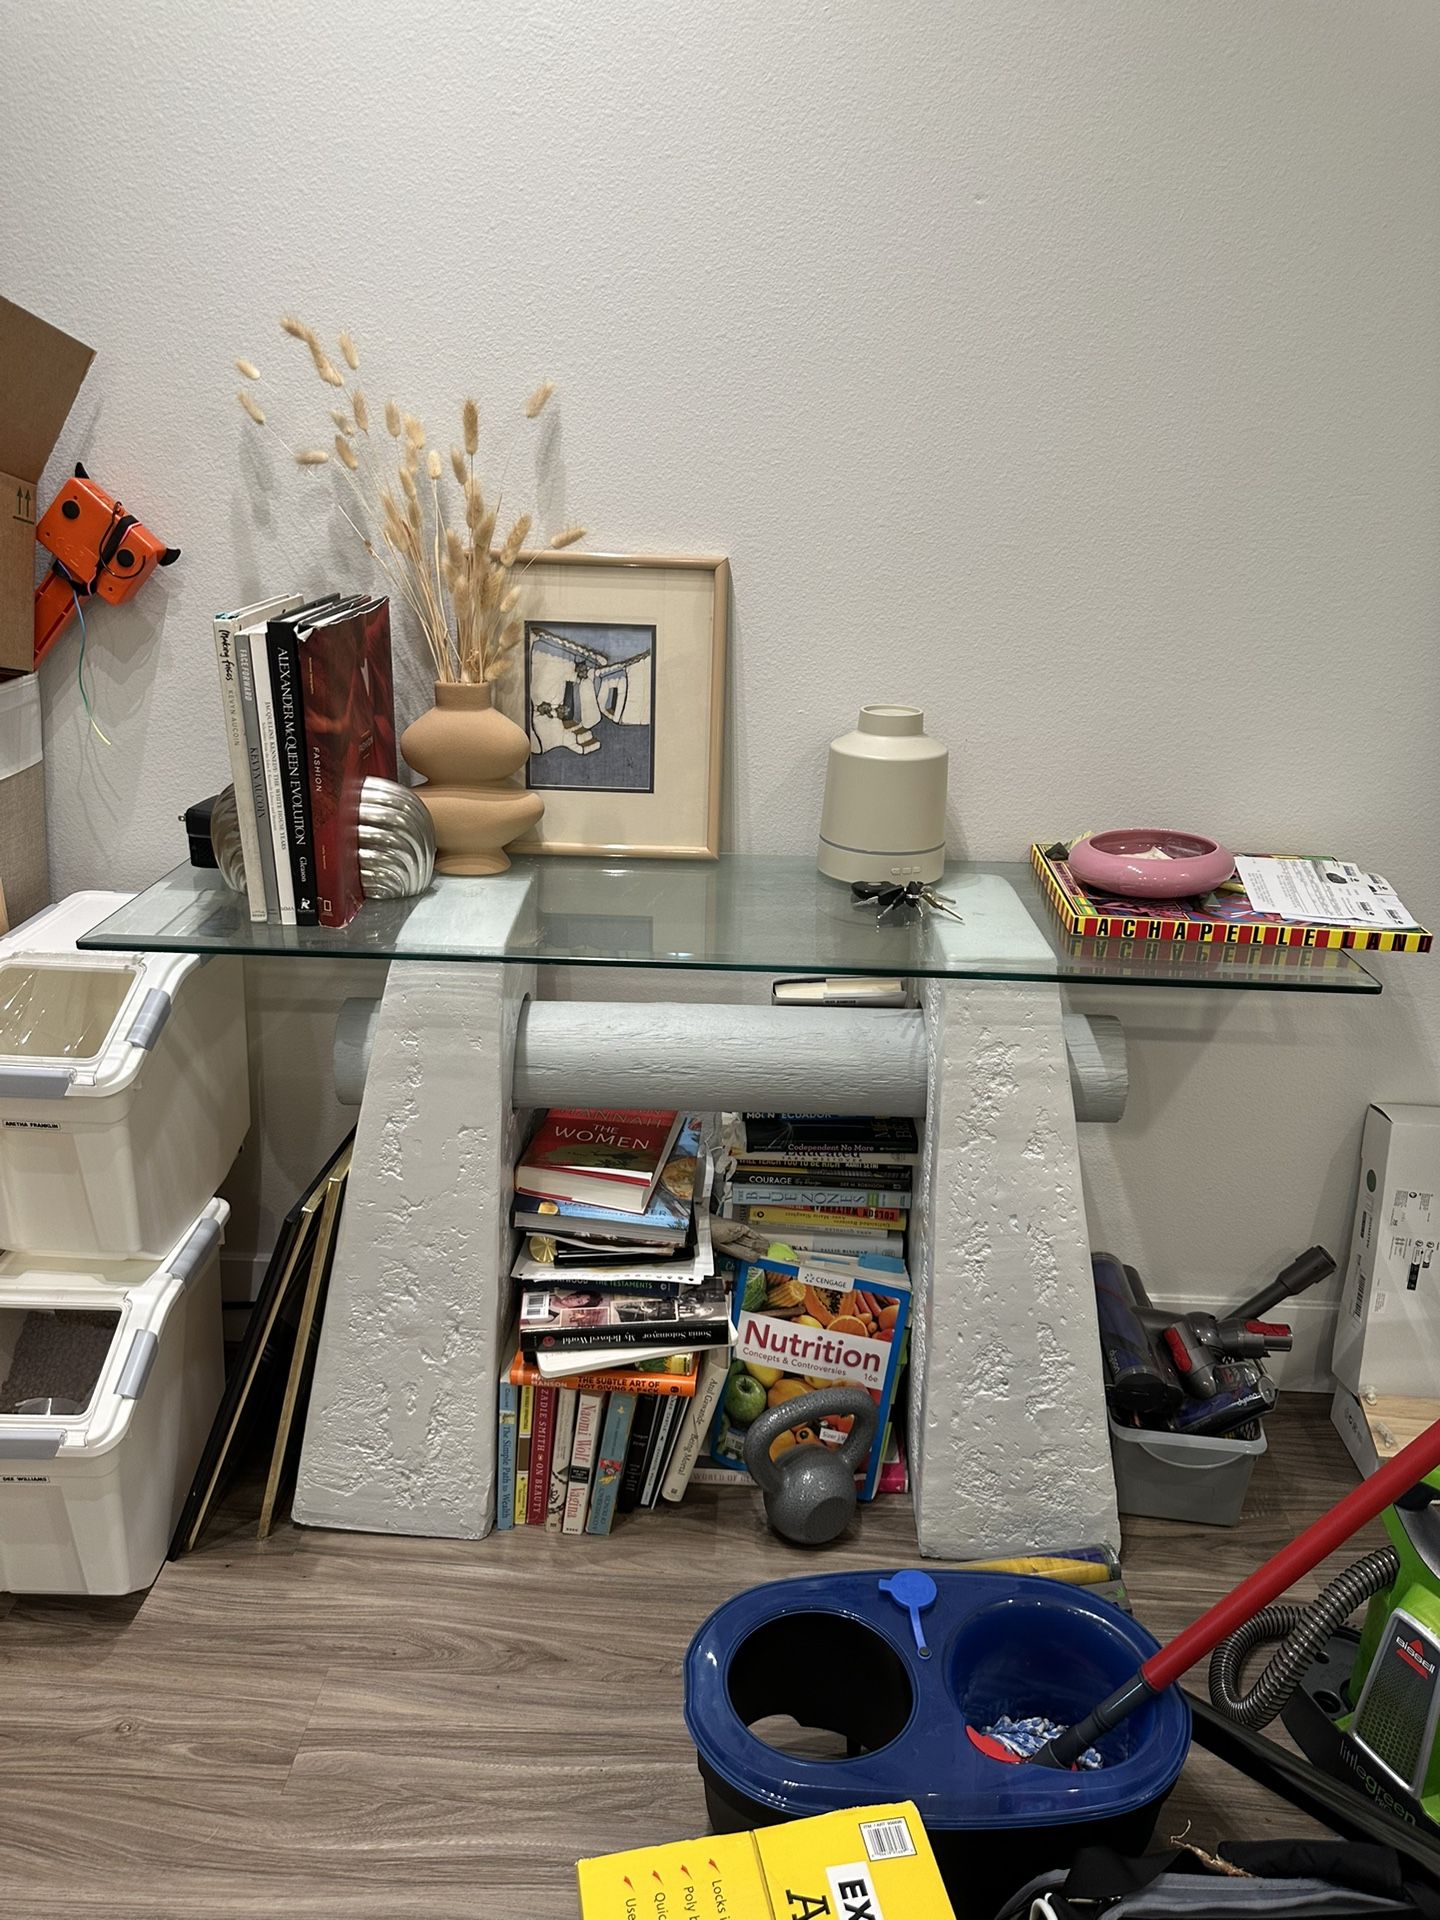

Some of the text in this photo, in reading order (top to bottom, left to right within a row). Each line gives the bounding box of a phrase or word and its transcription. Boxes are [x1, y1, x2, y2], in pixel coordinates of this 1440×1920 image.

[228, 690, 240, 746] KEVYN AUCOIN
[265, 702, 274, 739] JACQUELINE
[276, 646, 294, 720] ALEXANDER
[289, 780, 306, 846] EVOLUTION
[249, 747, 265, 818] KEVYN AUCOIN
[312, 747, 323, 792] FASHION
[298, 857, 309, 882] Gleason
[1072, 917, 1431, 952] LACHAPELLE LAND
[555, 1126, 650, 1150] WOMEN
[593, 1124, 620, 1134] THE
[788, 1143, 839, 1152] Codependent
[750, 1175, 792, 1184] COURAGE
[745, 1191, 797, 1203] BLUE
[802, 1192, 866, 1204] ZONES
[610, 1281, 653, 1289] TESTAMENTS
[816, 1276, 846, 1288] CENGAGE
[562, 1330, 712, 1345] Sonia Sotomayor My Beloved World
[744, 1320, 881, 1372] Nutrition
[743, 1348, 780, 1364] Concepts
[791, 1358, 847, 1376] Controversies
[578, 1376, 660, 1388] THE SUBTLE ART OF
[864, 1373, 878, 1383] 16e
[578, 1403, 597, 1435] Naomi
[502, 1440, 511, 1466] Simple
[532, 1389, 548, 1513] ZADIE SMITH ON BEAUTY
[574, 1438, 592, 1465] Wolf
[502, 1467, 511, 1487] Path
[678, 1453, 692, 1476] Mortal
[502, 1494, 511, 1519] Wealth
[567, 1487, 585, 1518] Vagina
[683, 1886, 698, 1912] Poly
[711, 1880, 727, 1914] Locks
